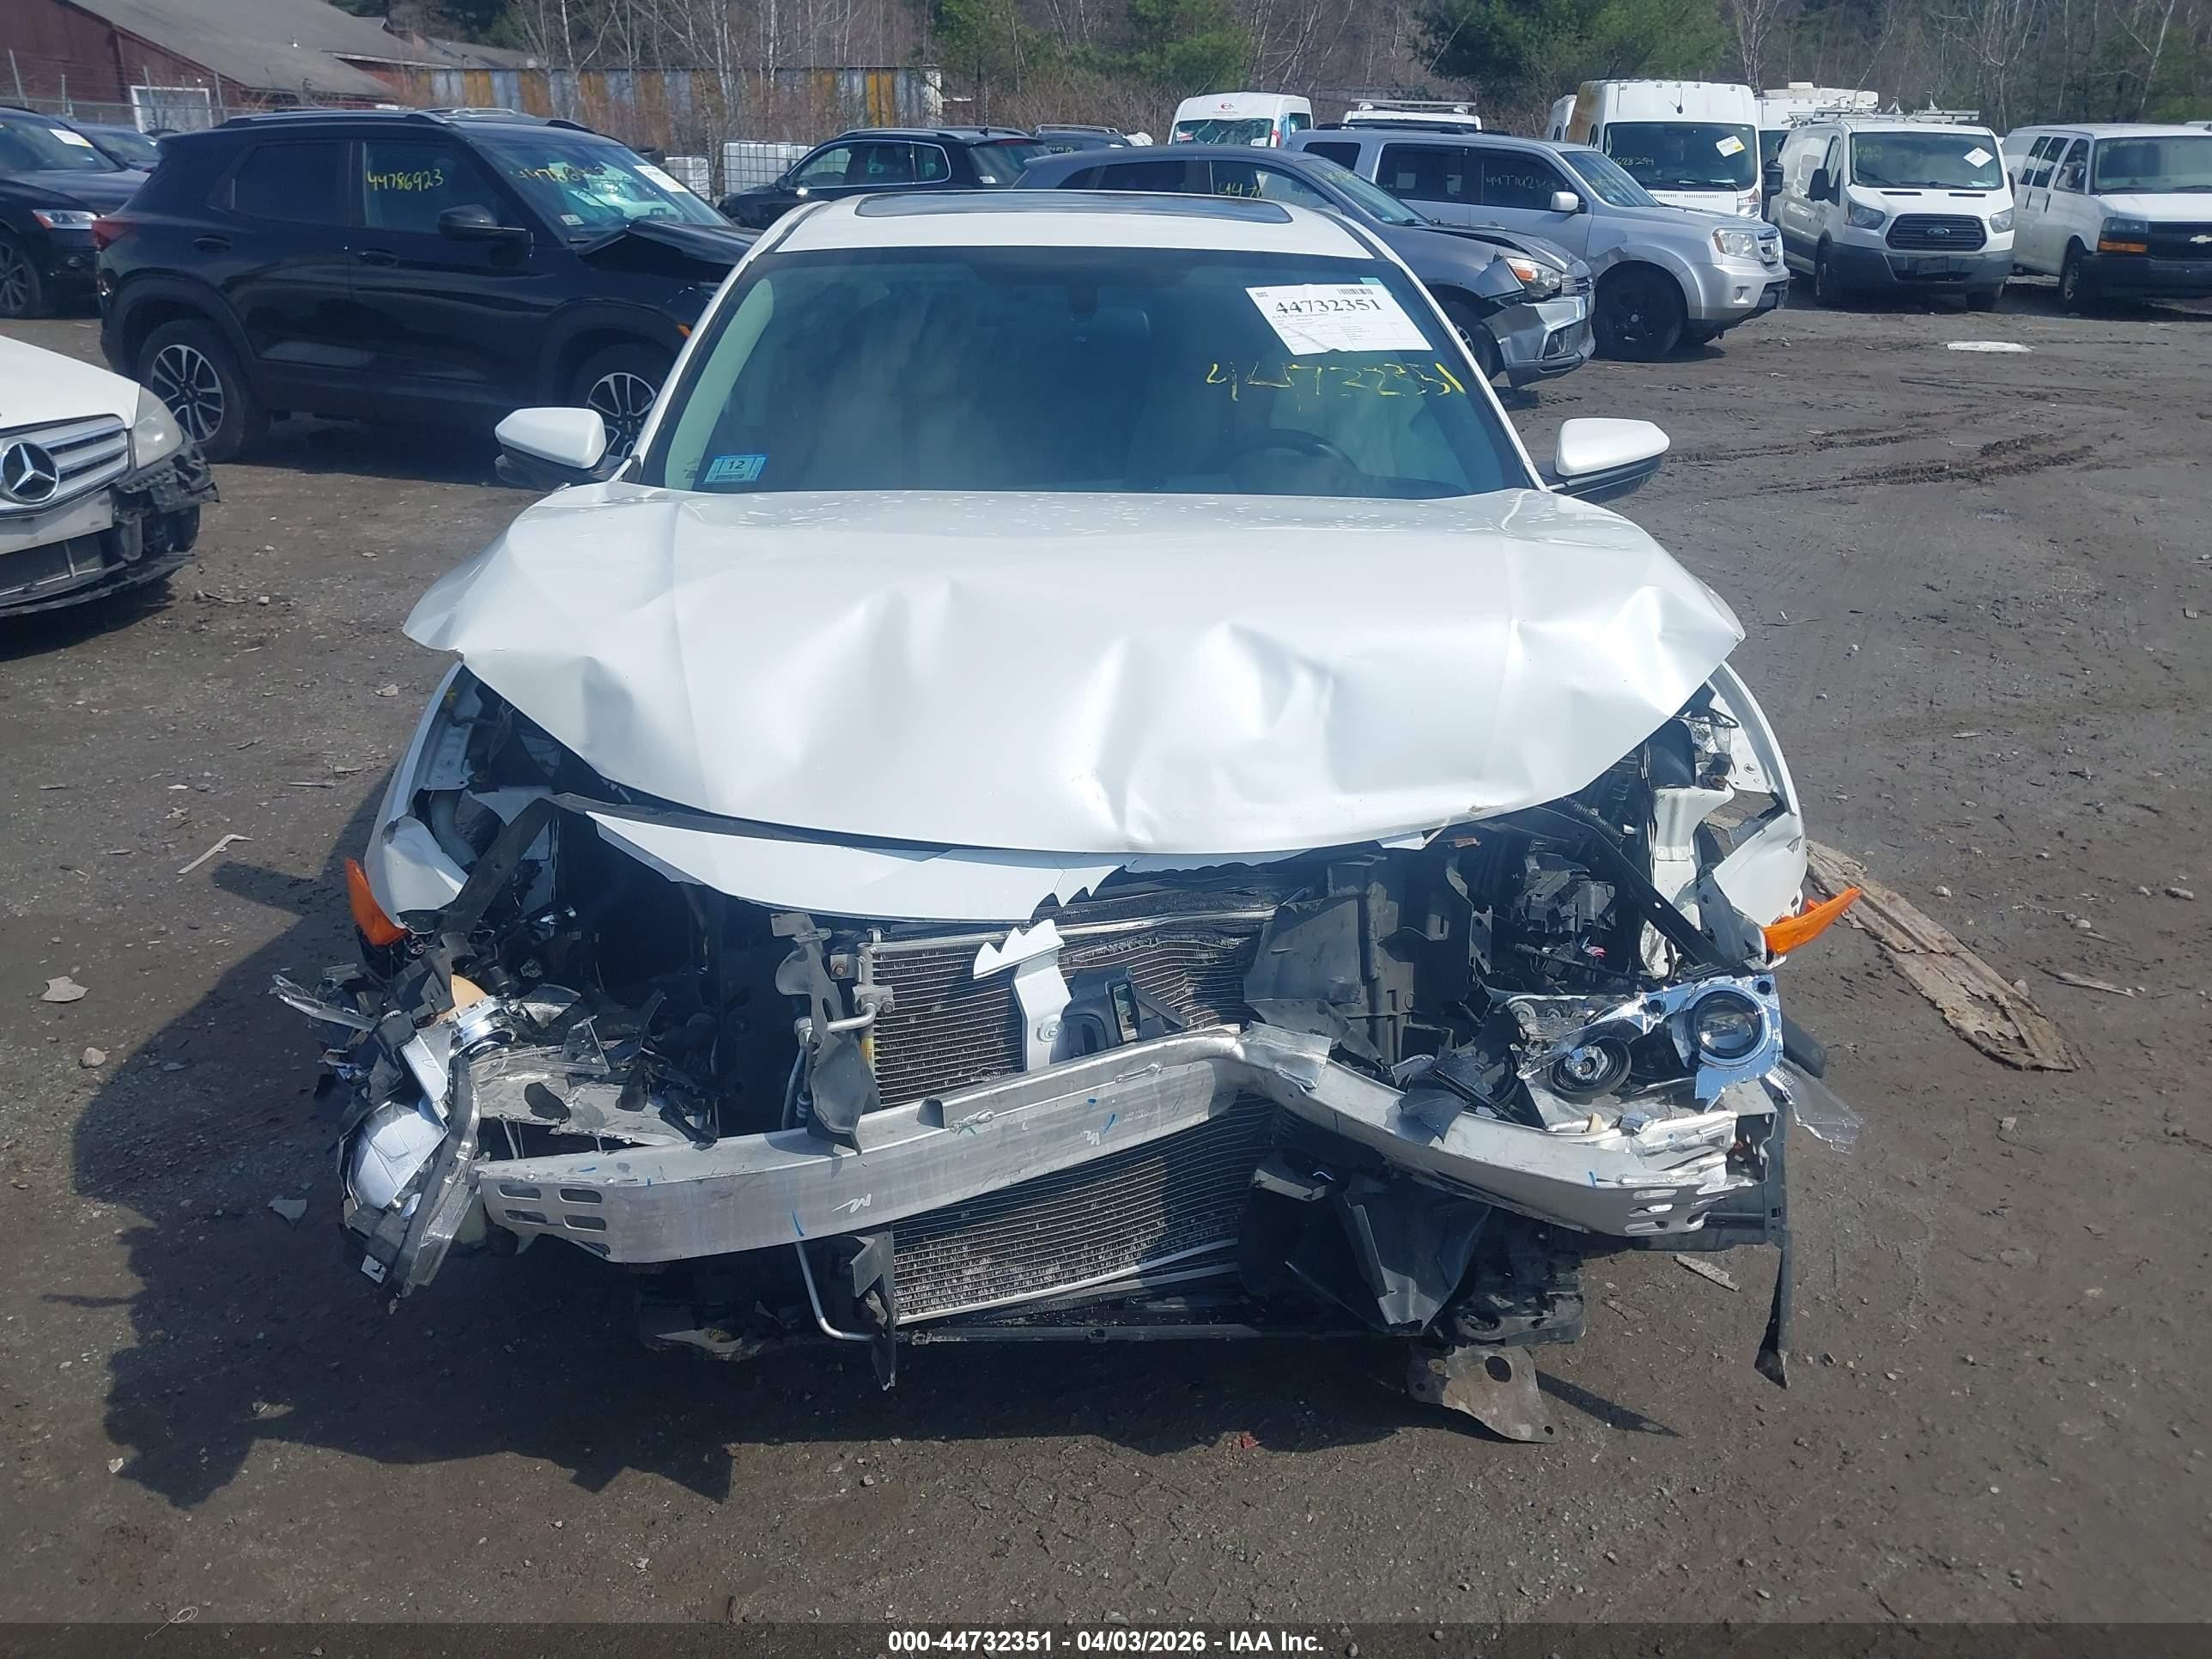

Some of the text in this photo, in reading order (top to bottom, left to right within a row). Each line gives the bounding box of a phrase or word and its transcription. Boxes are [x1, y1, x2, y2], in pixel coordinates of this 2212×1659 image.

[368, 168, 445, 191] 44786923
[1275, 299, 1384, 314] 44732351
[727, 460, 745, 471] 12
